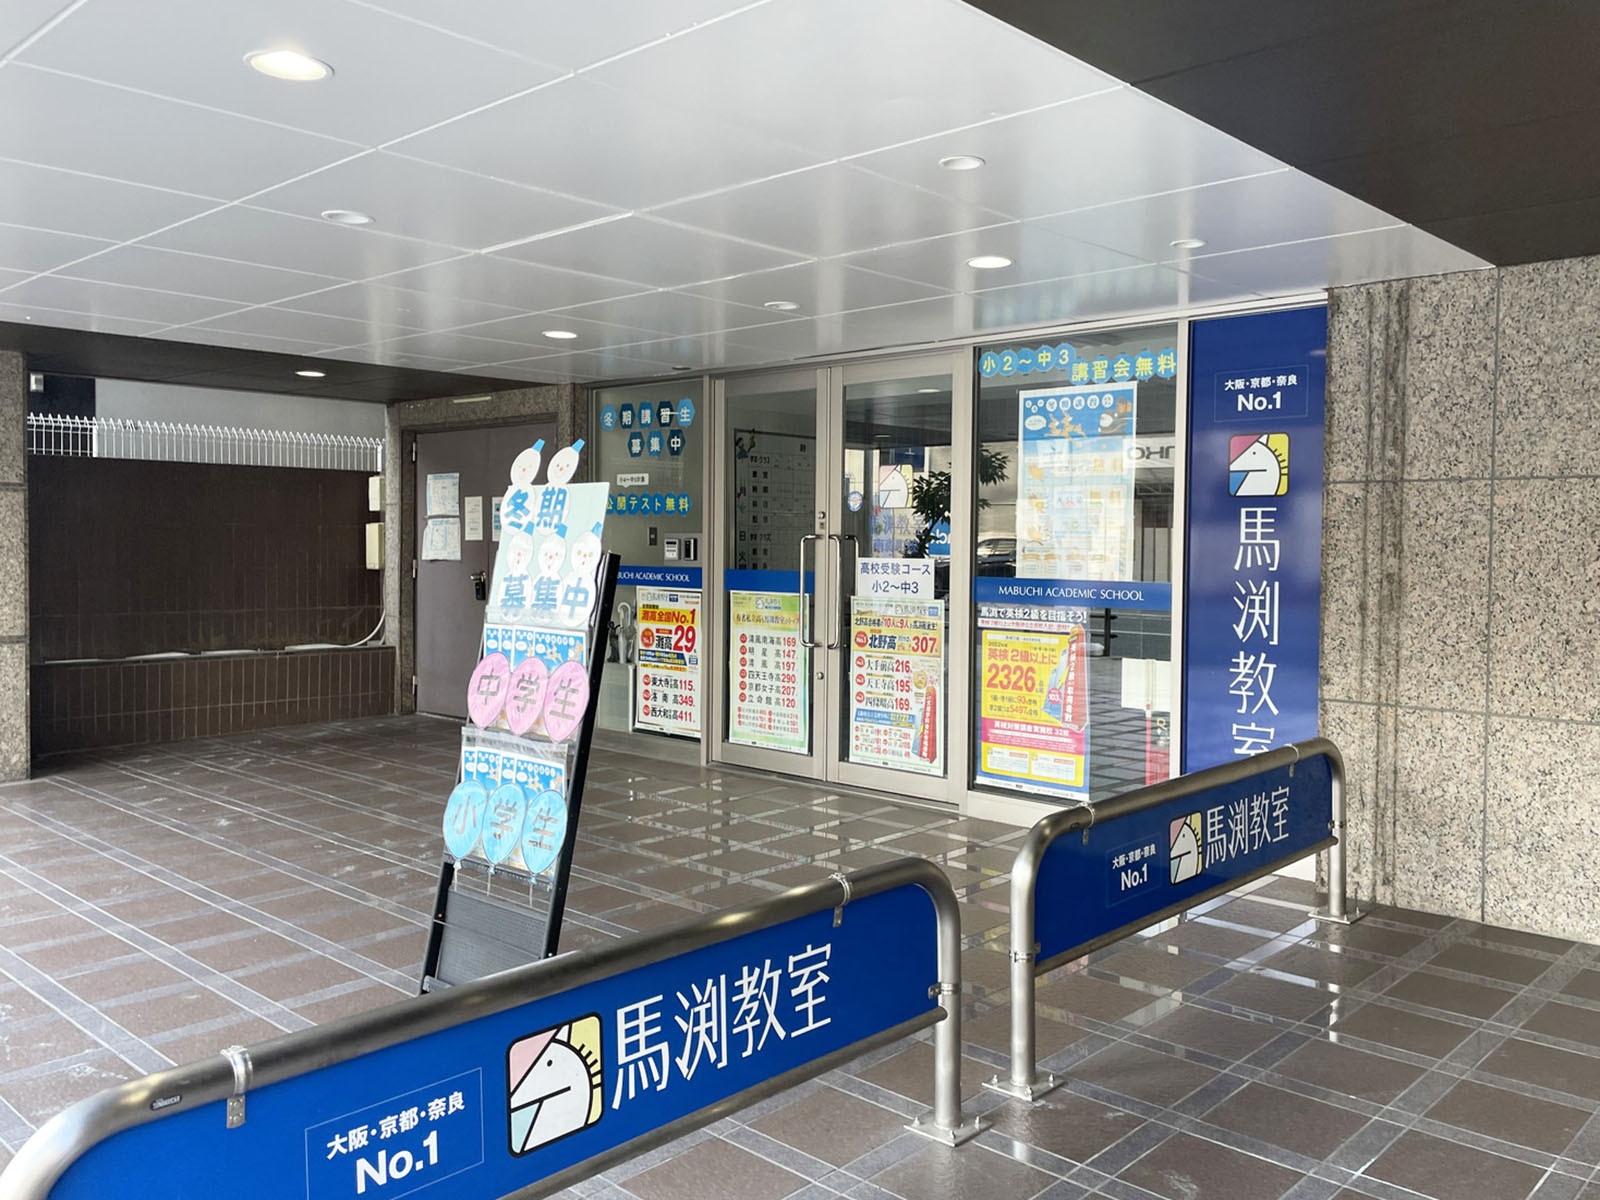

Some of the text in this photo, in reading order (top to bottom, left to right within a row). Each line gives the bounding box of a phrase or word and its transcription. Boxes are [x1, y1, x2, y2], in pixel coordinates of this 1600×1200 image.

[1072, 353, 1177, 382] 講習会無料
[1237, 391, 1281, 411] No.1
[631, 436, 681, 453] 募集中
[503, 487, 568, 530] 冬期
[634, 571, 665, 582] ACADEMIC
[665, 572, 690, 583] SCHOOL
[860, 562, 931, 575] 高校受験コース
[500, 574, 590, 617] 募集中
[998, 586, 1145, 601] MABUCHI ACADEMIC SCHOOL
[673, 625, 696, 653] 29
[1228, 506, 1281, 757] 馬渕教室
[782, 637, 796, 647] 169
[869, 634, 897, 650] 北野高
[911, 636, 937, 653] 307
[782, 649, 796, 659] 147
[782, 661, 796, 671] 197
[895, 660, 910, 673] 216
[679, 679, 693, 691] 115
[782, 673, 796, 684] 290
[895, 679, 910, 693] 195
[986, 663, 1036, 693] 2326
[477, 667, 579, 720] 中学生
[782, 685, 796, 696] 207
[782, 697, 796, 708] 120
[894, 698, 909, 711] 169
[678, 709, 693, 722] 411
[453, 795, 558, 850] 小学生
[1205, 786, 1290, 869] 馬渕教室
[1121, 863, 1148, 891] No.1
[612, 943, 832, 1110] 馬渕教室
[326, 1091, 465, 1160] 大阪・京都・奈良
[356, 1130, 438, 1194] No.1
